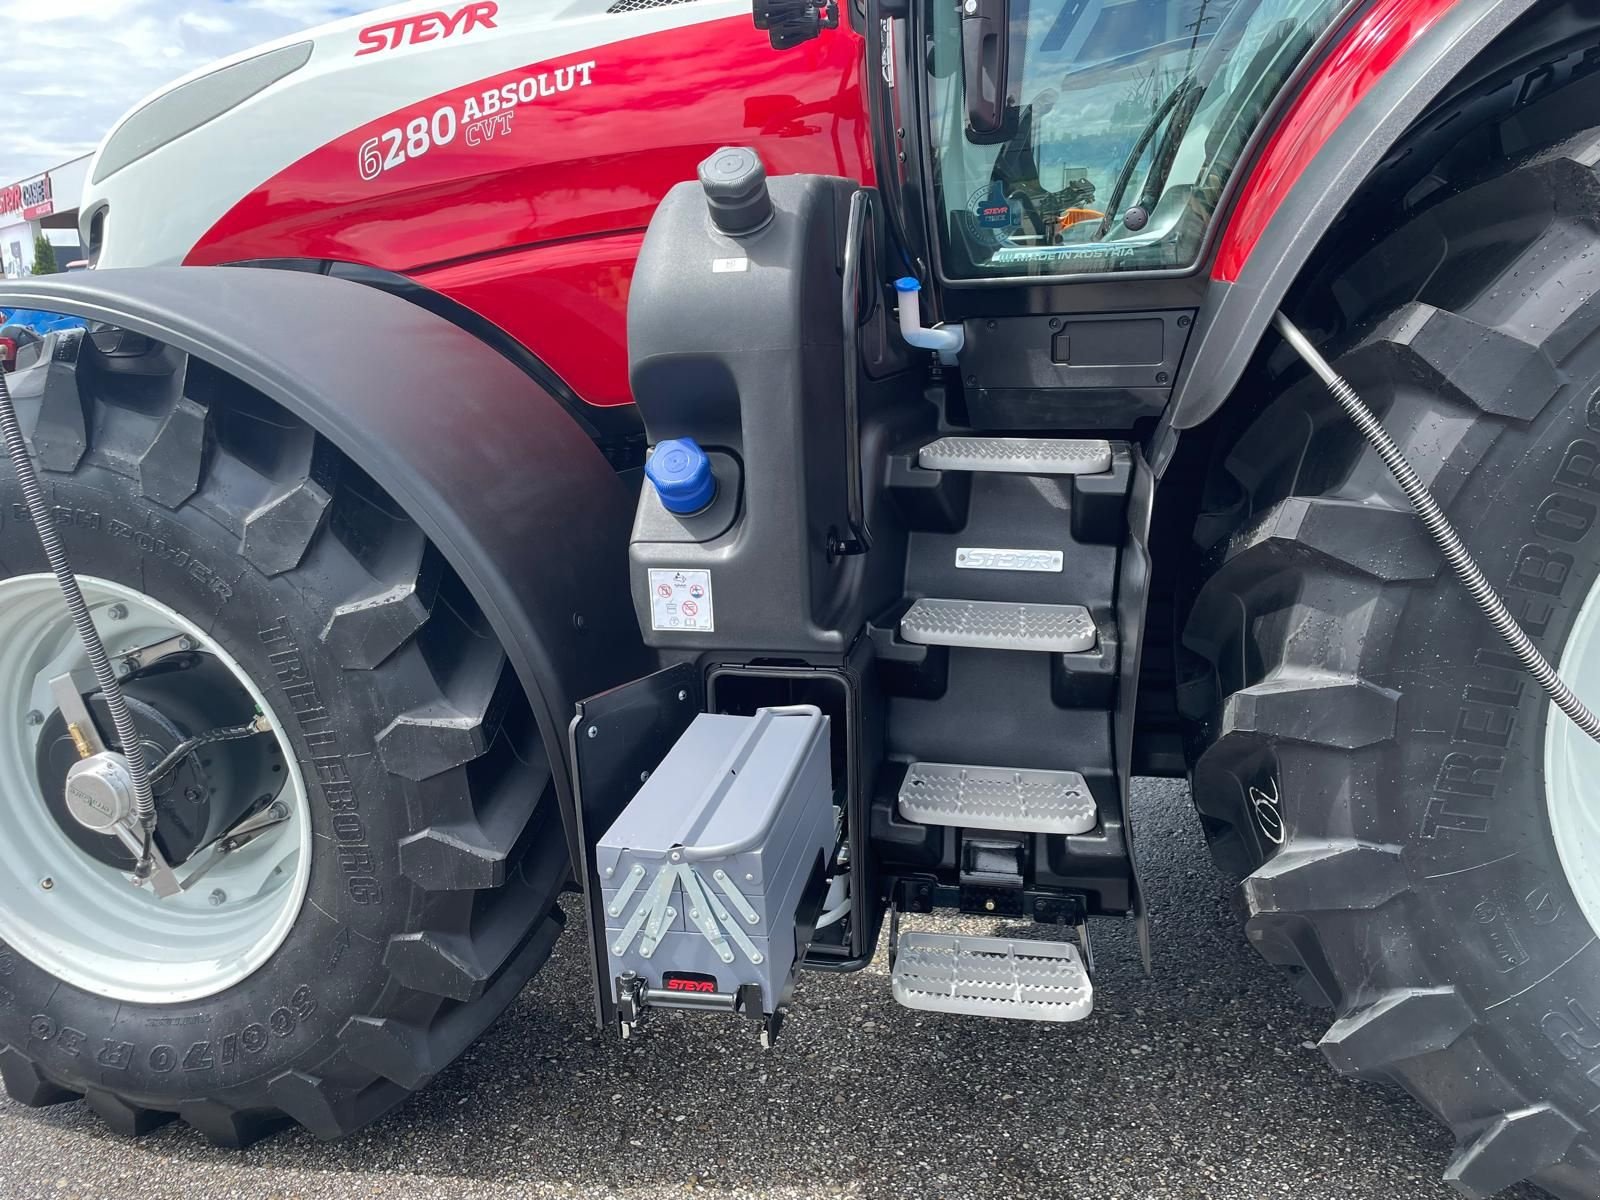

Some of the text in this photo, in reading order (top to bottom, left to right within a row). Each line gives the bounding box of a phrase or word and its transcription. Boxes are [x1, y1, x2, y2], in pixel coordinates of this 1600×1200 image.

[354, 0, 499, 57] STEYR
[358, 60, 597, 181] 6280 ABSOLUT
[465, 111, 514, 147] CVT
[983, 206, 1008, 216] STEYR
[1016, 247, 1135, 262] MADE IN AUSTRIA
[12, 502, 101, 531] HGH
[965, 549, 1053, 569] STEYR
[258, 615, 385, 905] TRELLEBORG
[667, 979, 714, 993] STEYR
